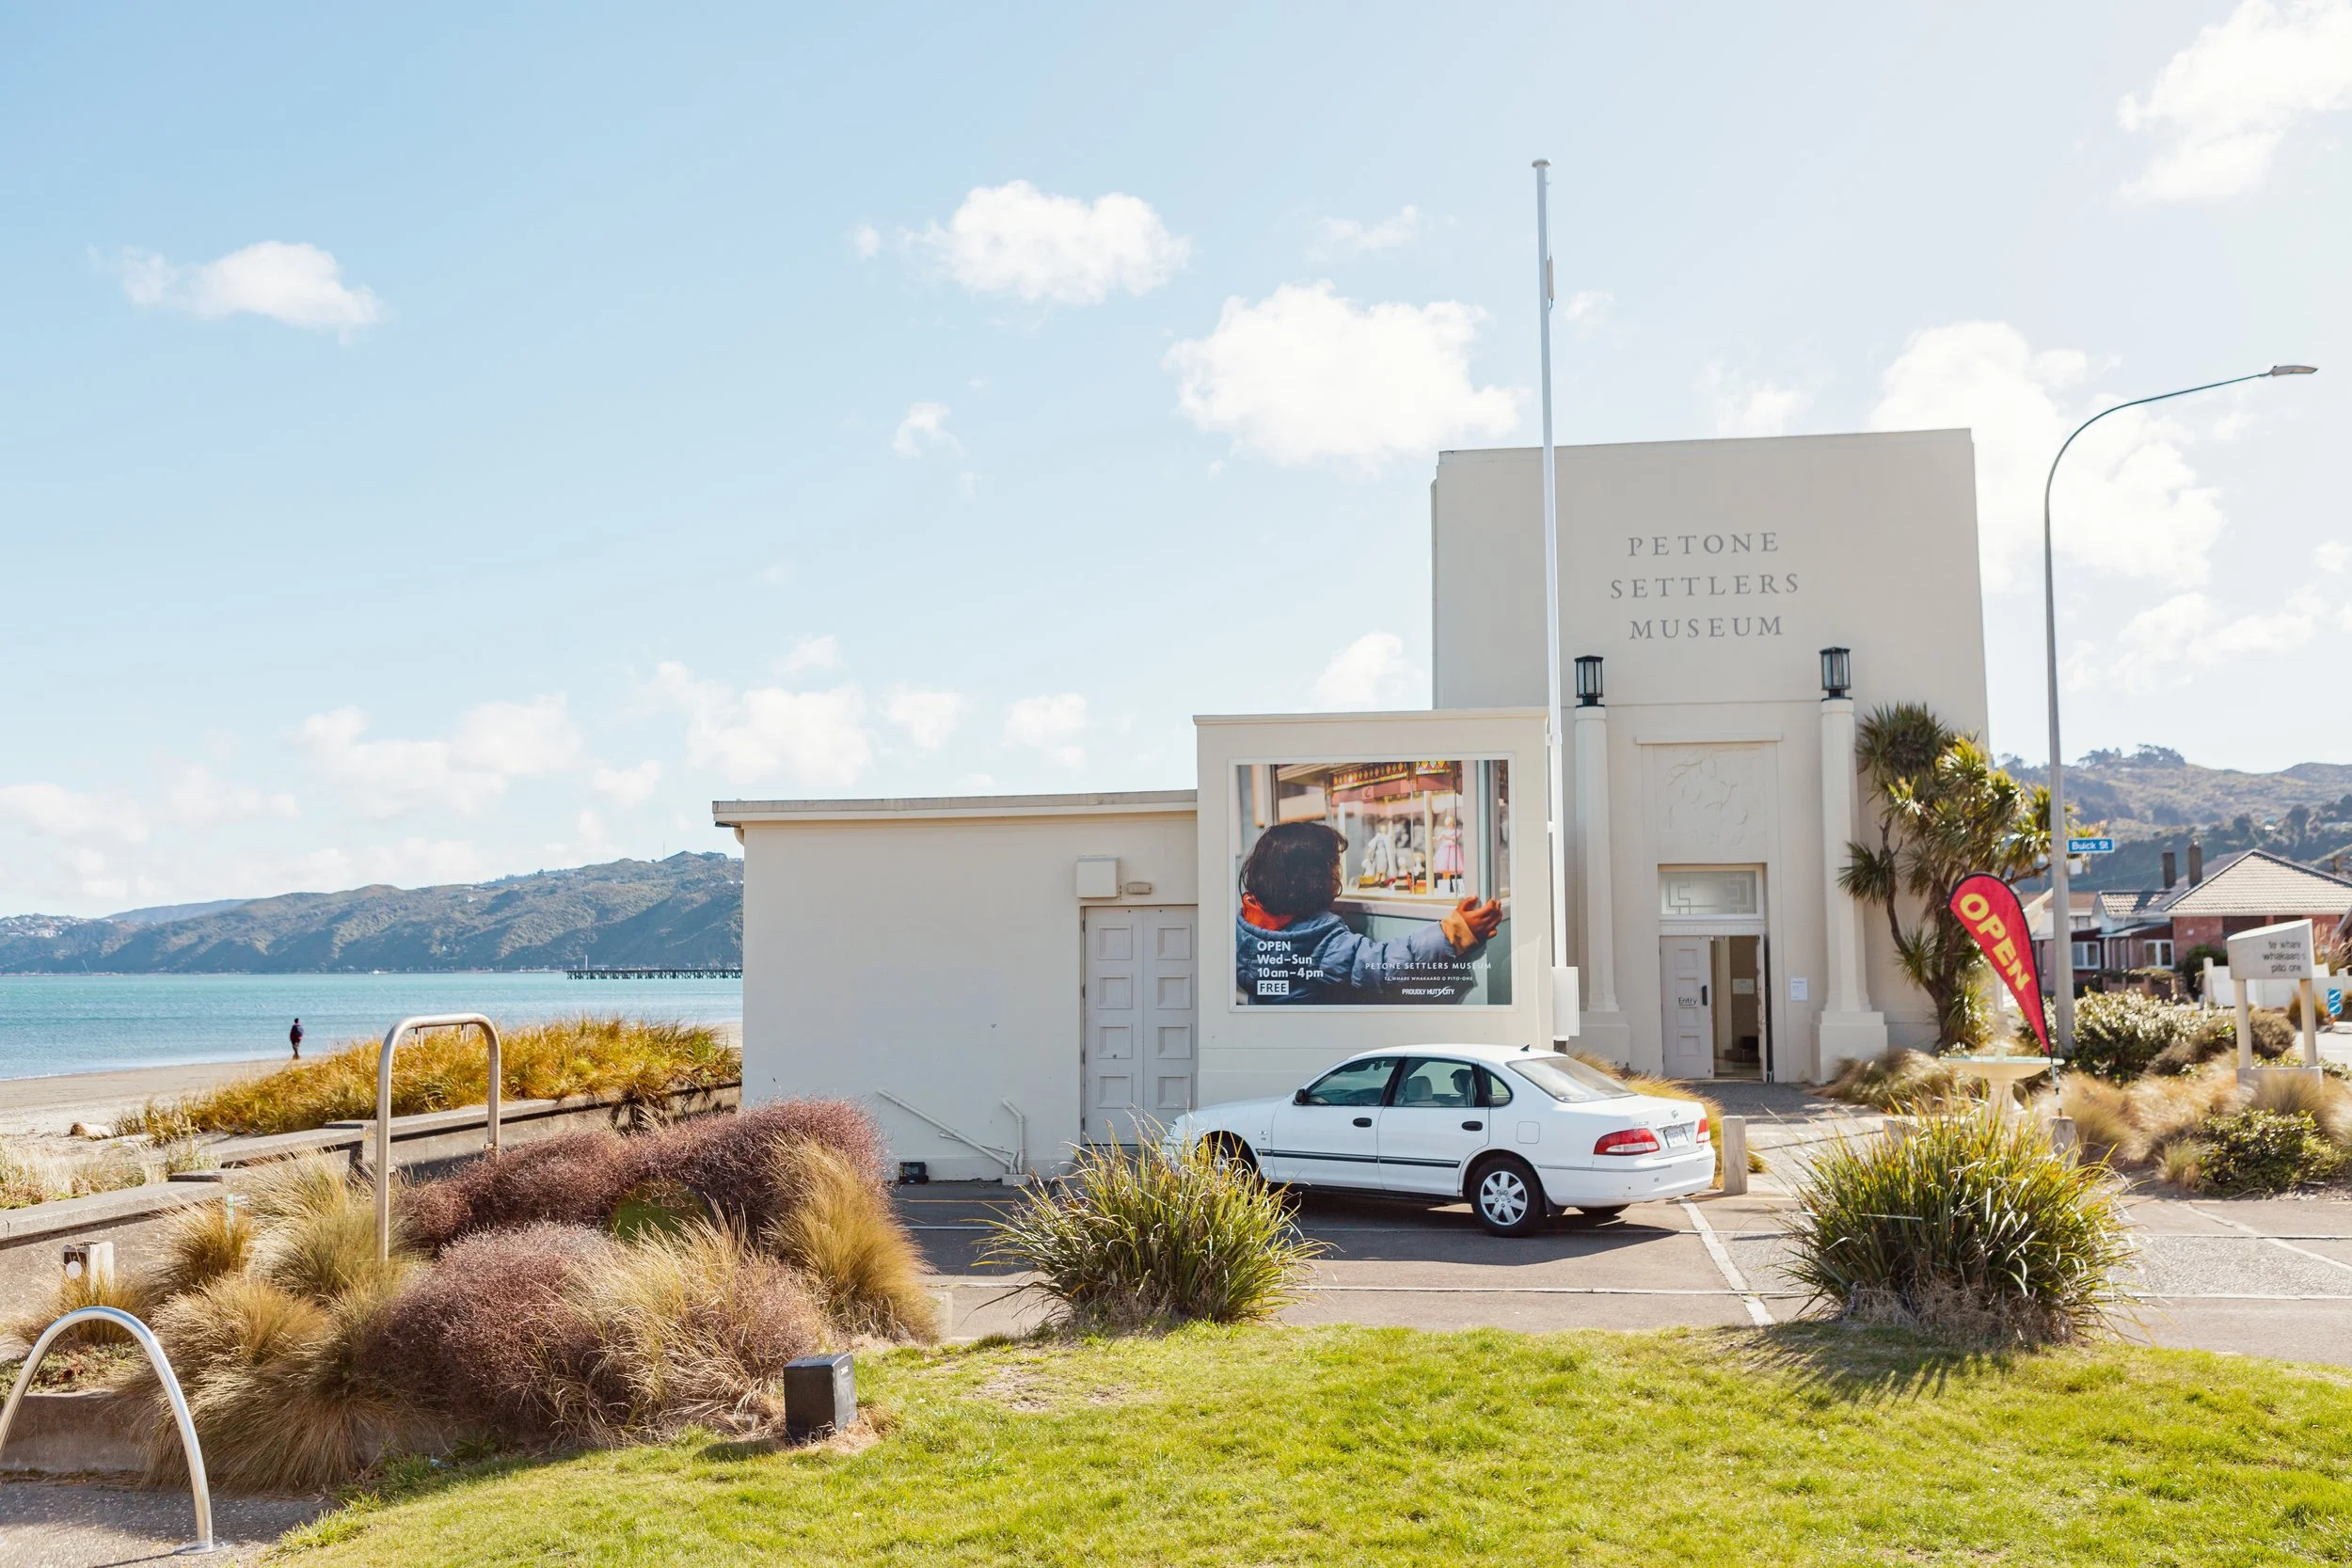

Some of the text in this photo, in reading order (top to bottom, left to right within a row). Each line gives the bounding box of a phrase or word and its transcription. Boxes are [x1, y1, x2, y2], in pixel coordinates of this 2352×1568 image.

[1628, 531, 1779, 557] PETONE
[1611, 573, 1799, 599] SETTLERS
[1629, 616, 1783, 640] MUSEUM
[2072, 841, 2108, 850] Buick St
[1256, 941, 1292, 952] OPEN
[1959, 893, 2032, 991] OPEN
[1260, 983, 1287, 993] FREE
